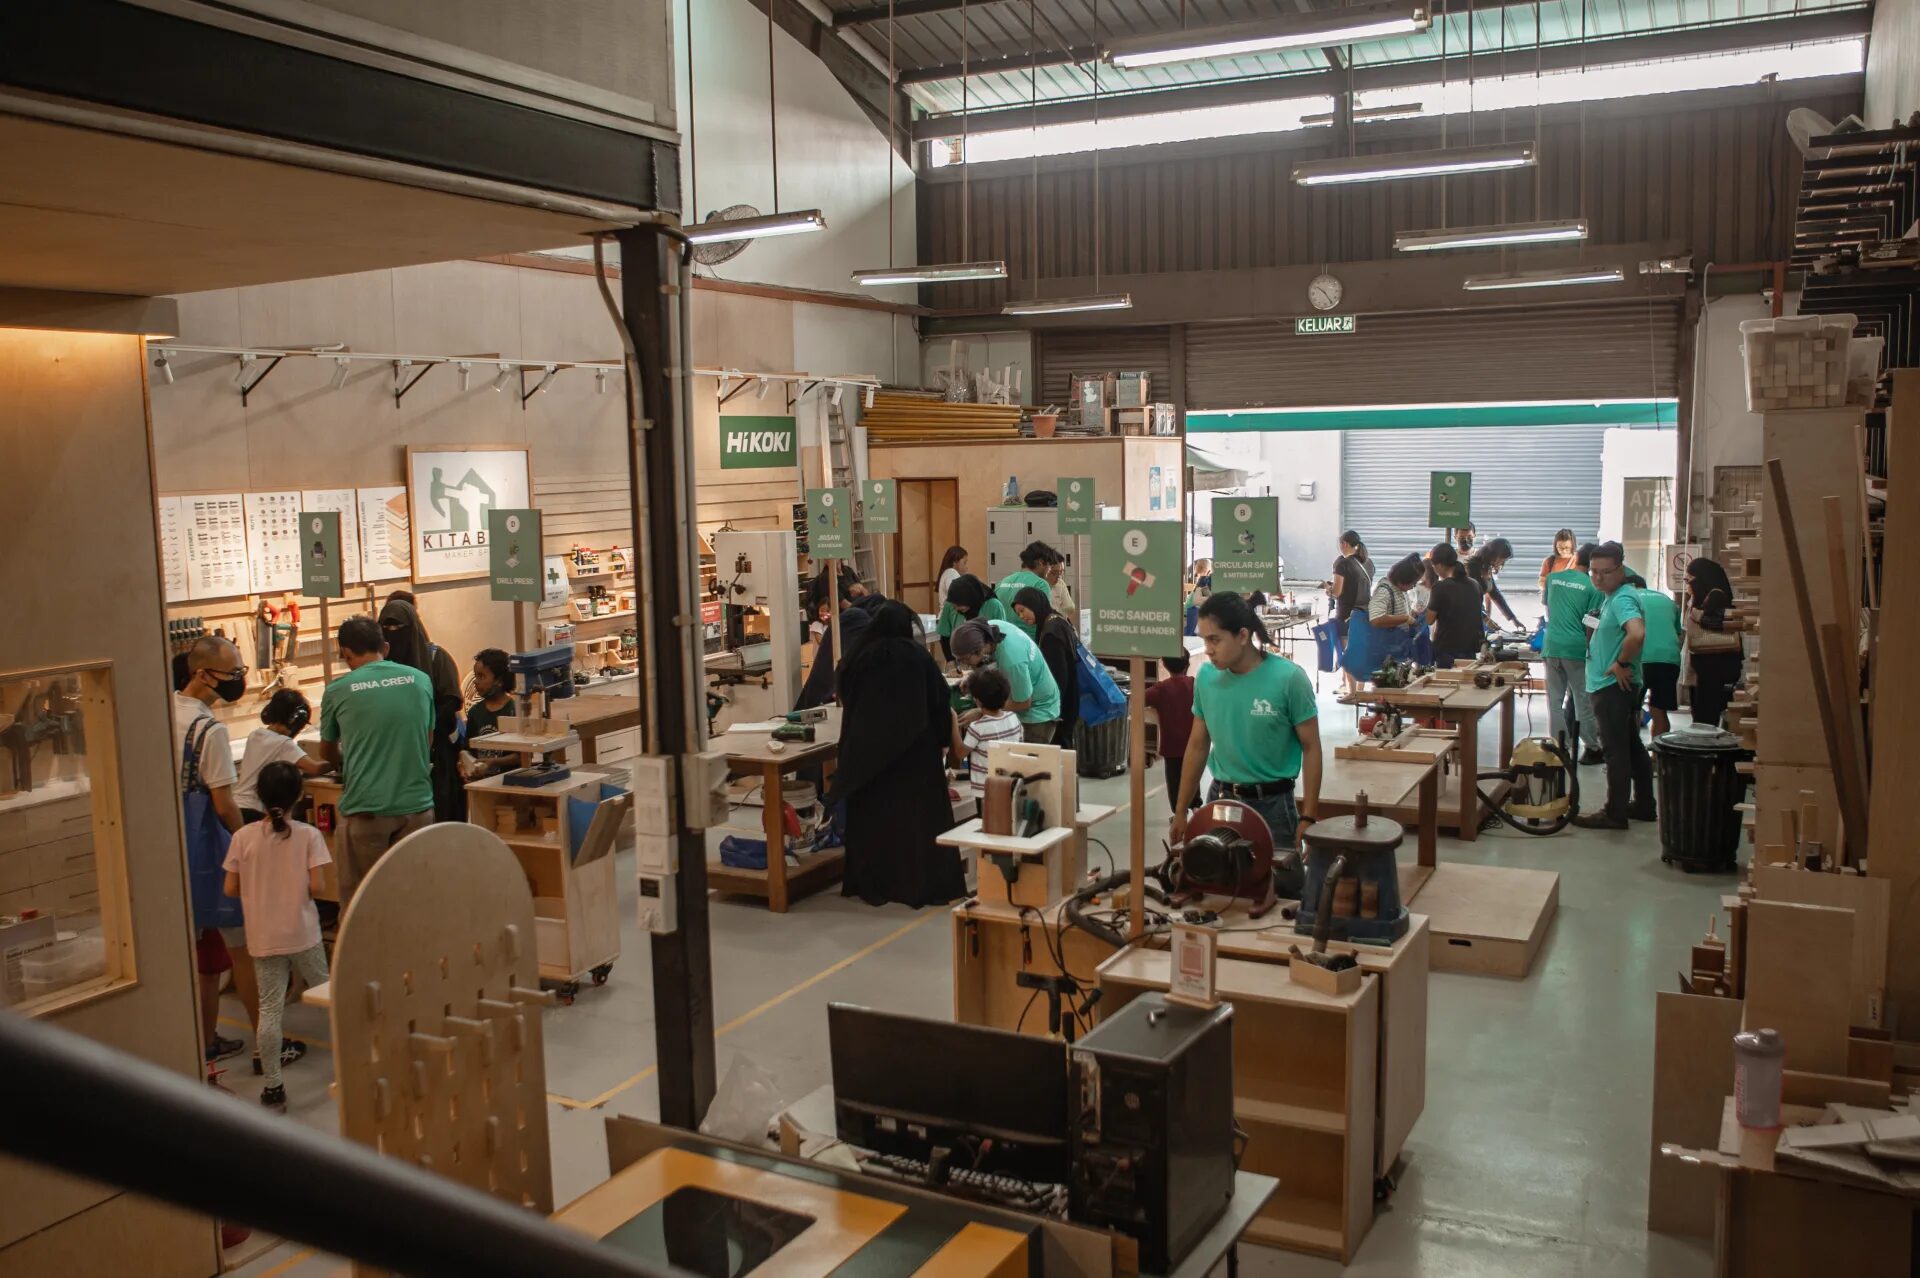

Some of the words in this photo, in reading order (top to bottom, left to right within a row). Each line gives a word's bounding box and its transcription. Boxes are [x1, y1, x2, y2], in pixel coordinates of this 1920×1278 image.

[1298, 317, 1341, 332] KELUAR
[1240, 509, 1246, 517] B
[1131, 538, 1139, 548] E
[1214, 561, 1253, 569] CIRCULAR
[1254, 561, 1274, 569] SAW
[496, 577, 513, 585] DRILL
[1566, 582, 1586, 591] CREW
[1100, 609, 1125, 620] DISC
[1126, 610, 1171, 621] SANDER
[1096, 624, 1102, 632] &
[1103, 624, 1138, 634] SPINDLE
[1140, 626, 1176, 635] SANDER
[350, 681, 378, 692] BINA
[381, 675, 415, 688] CREW
